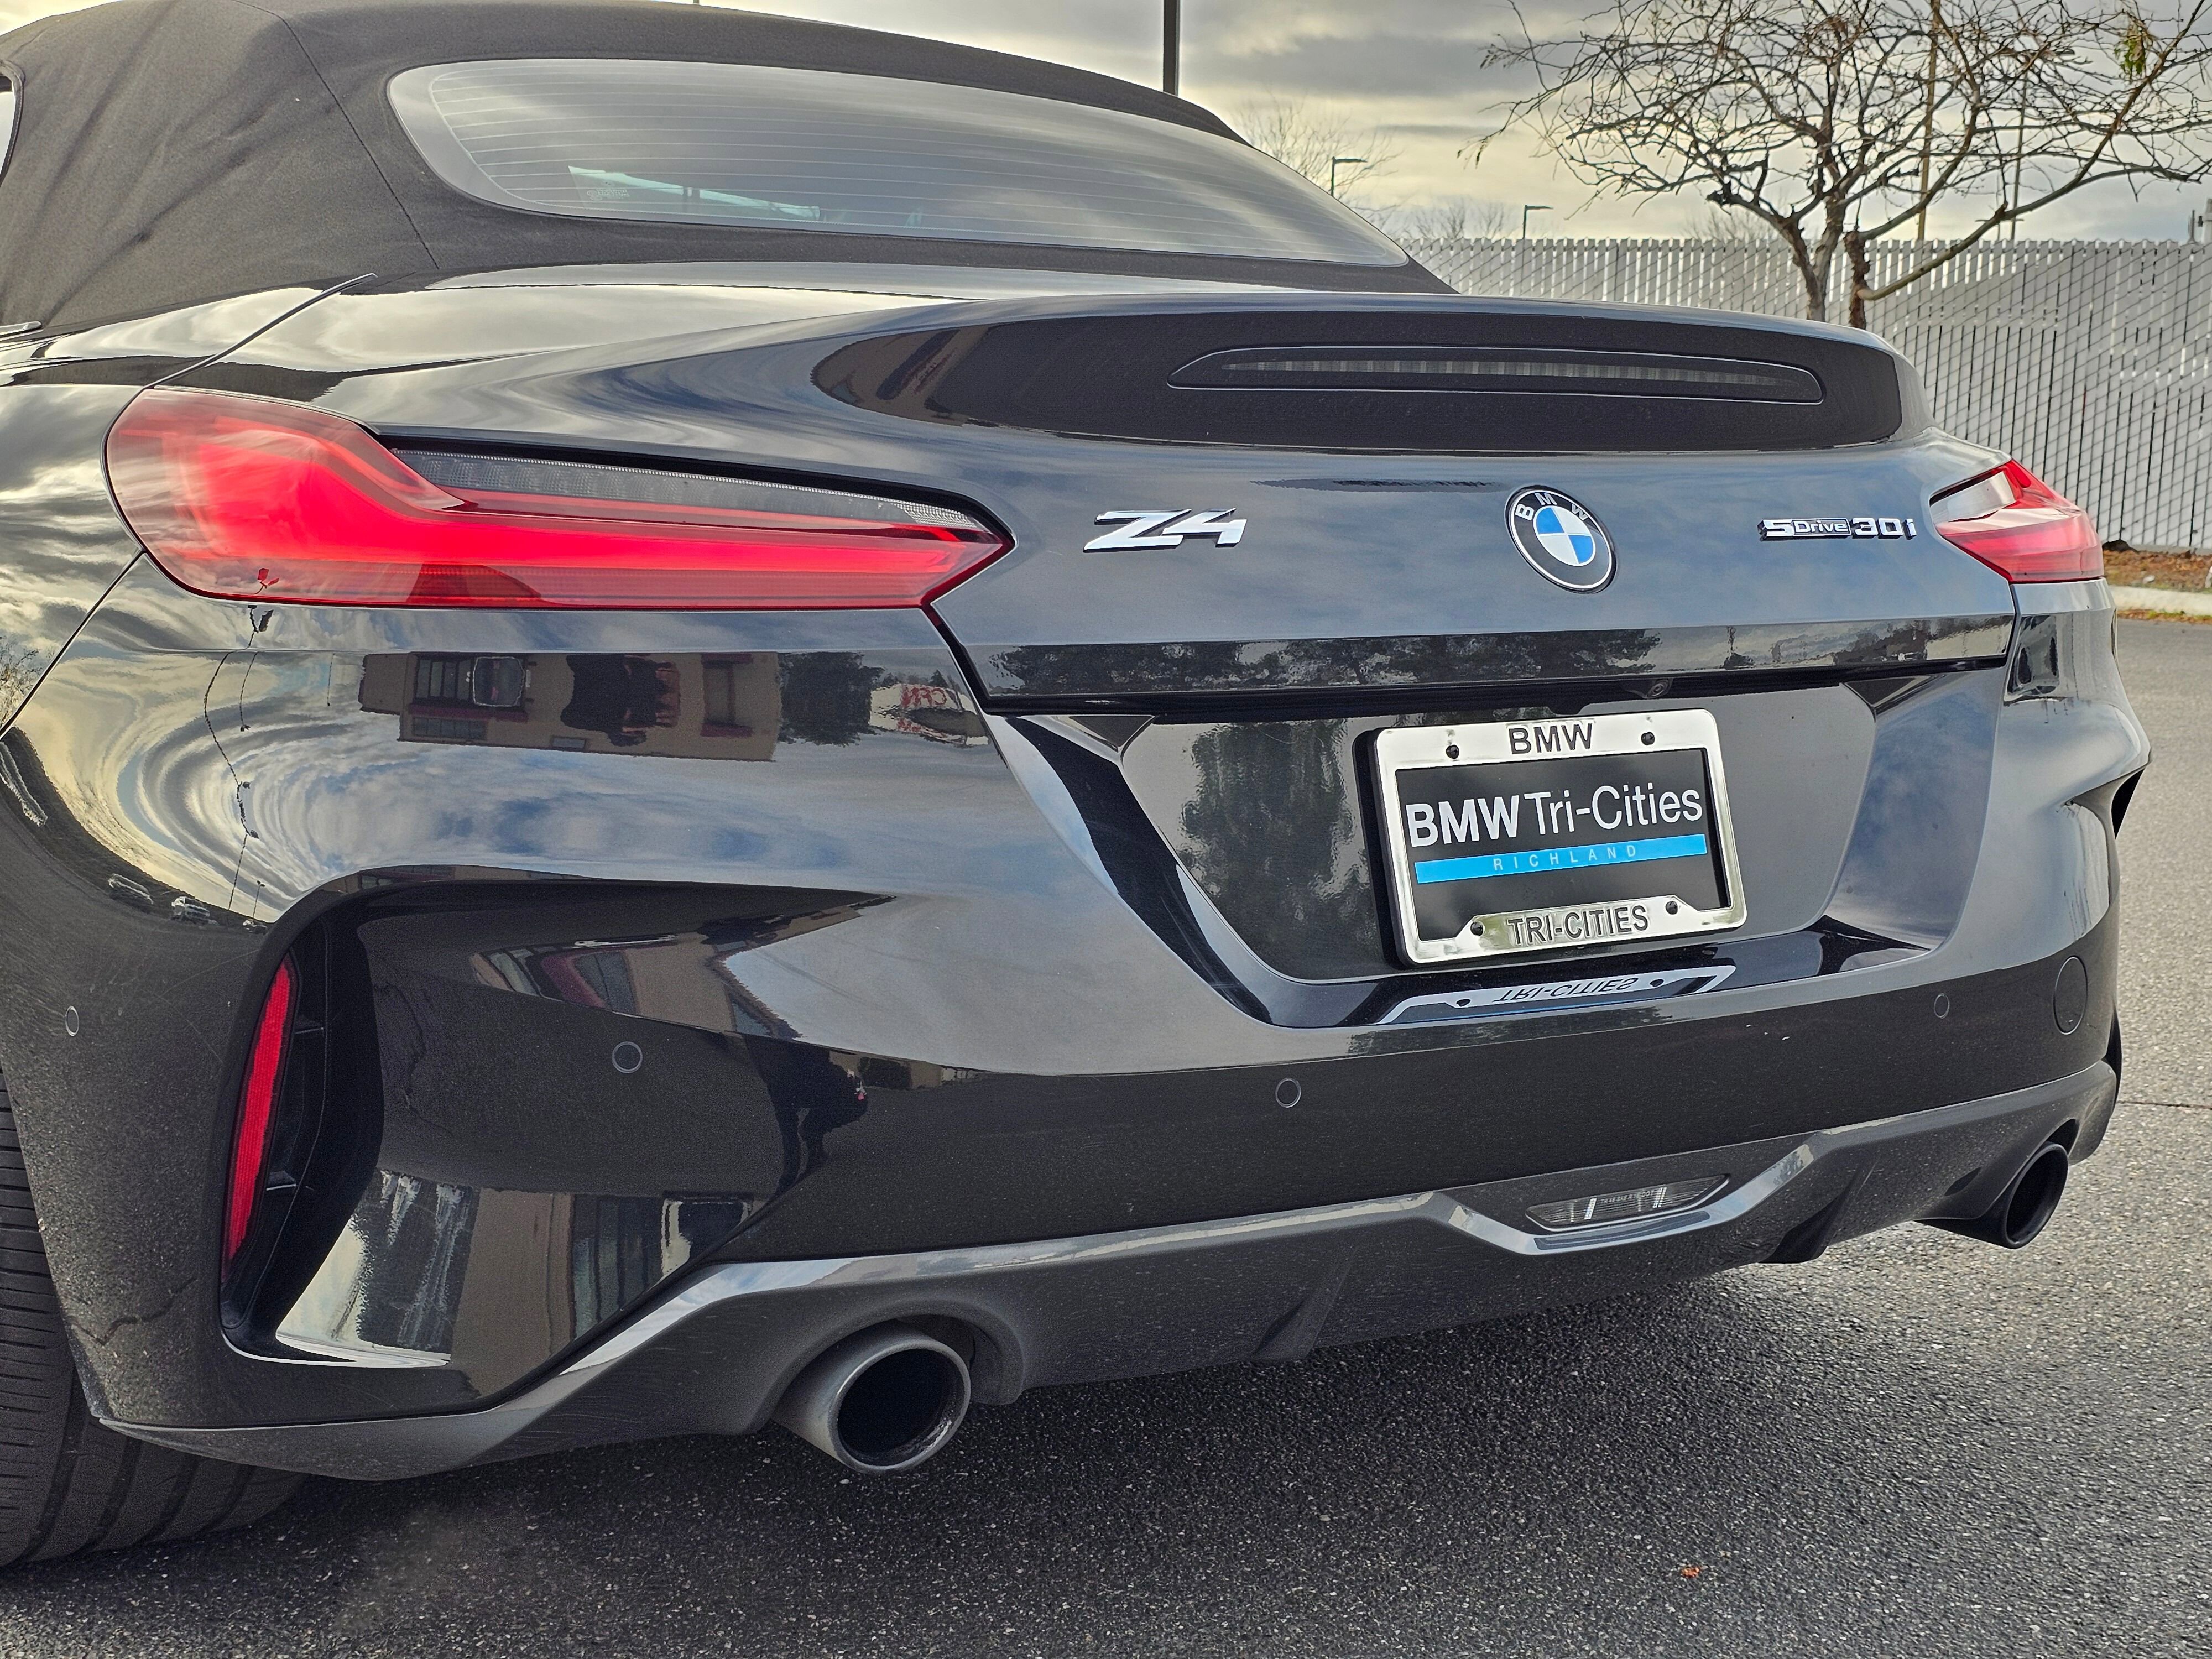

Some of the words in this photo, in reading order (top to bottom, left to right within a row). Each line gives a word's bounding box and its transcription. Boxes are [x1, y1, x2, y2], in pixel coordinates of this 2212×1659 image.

[1515, 493, 1589, 521] BMW
[1083, 508, 1247, 552] Z4
[1509, 722, 1593, 755] BMW
[1405, 796, 1520, 848] BMW
[1524, 782, 1703, 835] Tri-Cities
[1493, 844, 1636, 872] RICHLAND
[1507, 905, 1651, 946] TRI-CITIES
